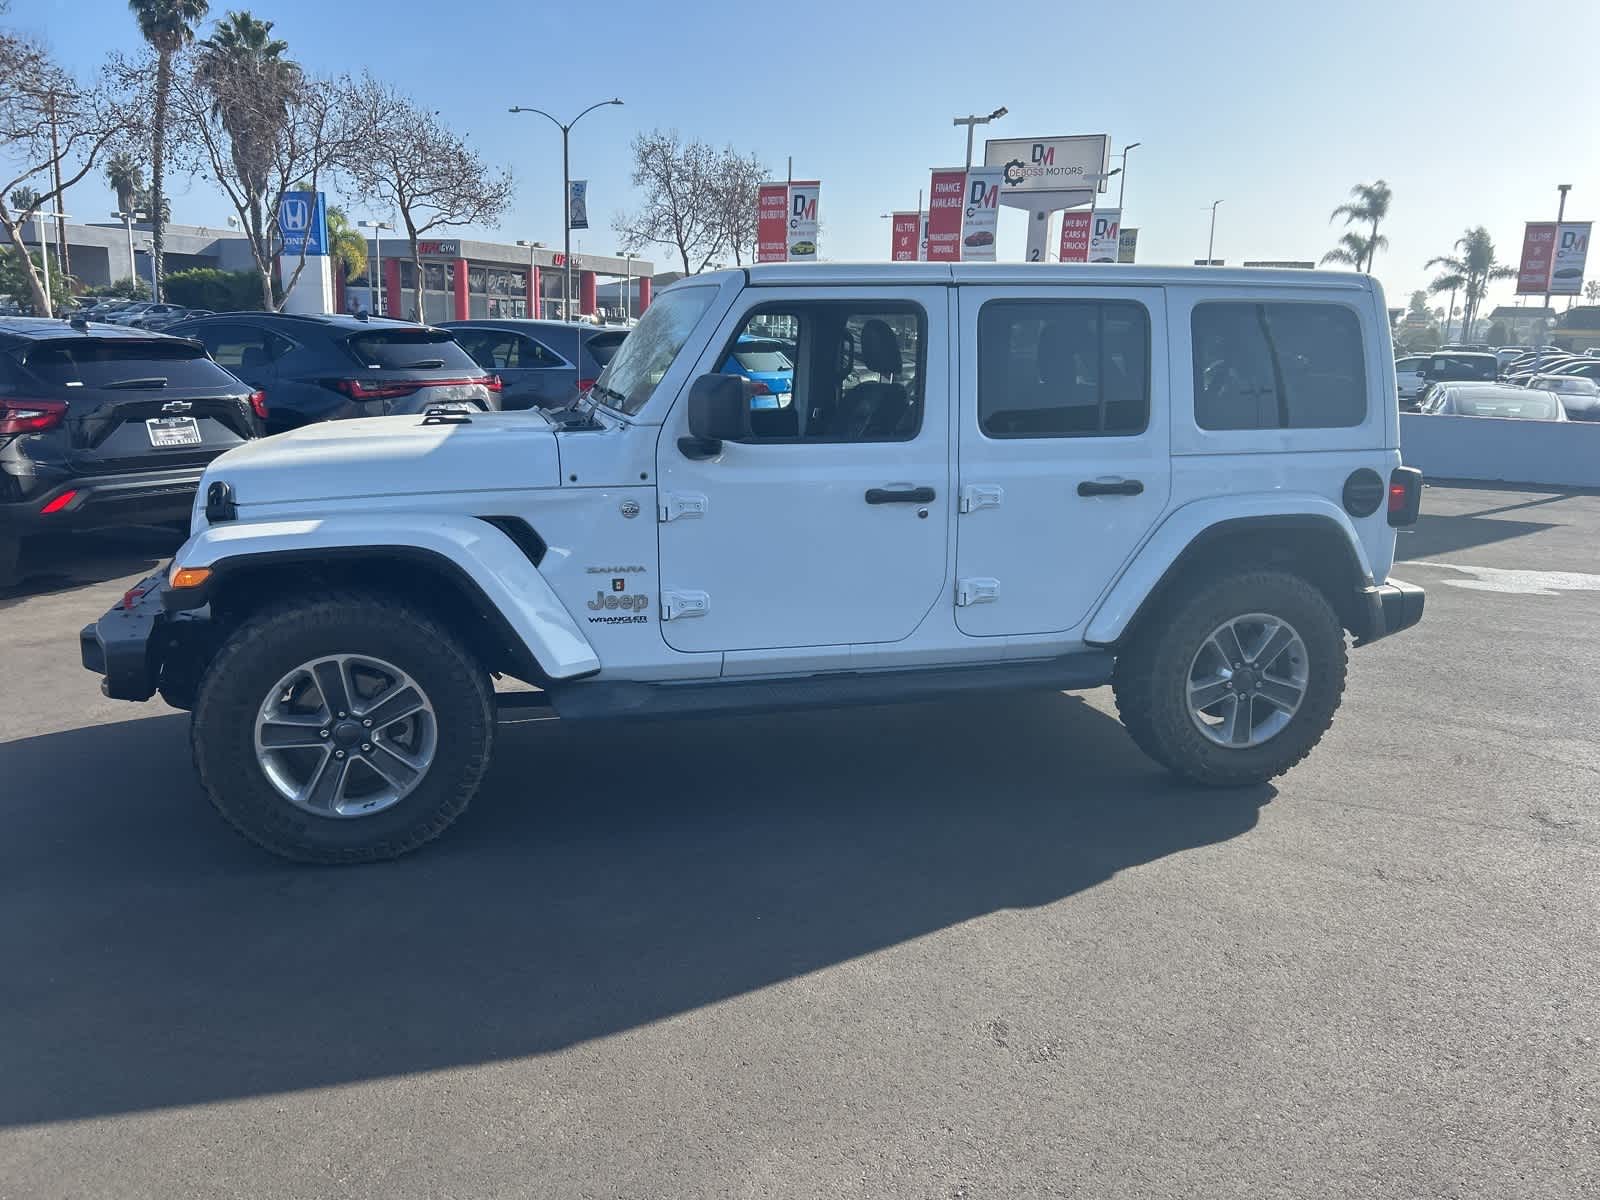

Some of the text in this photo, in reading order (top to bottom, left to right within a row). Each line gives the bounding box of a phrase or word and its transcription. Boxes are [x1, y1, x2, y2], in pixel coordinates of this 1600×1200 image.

[1032, 144, 1055, 166] DM
[1010, 166, 1084, 177] DEBOSS MOTORS
[935, 182, 961, 193] FINANCE
[970, 181, 999, 209] DM
[793, 194, 817, 220] DM
[931, 198, 962, 209] AVAILABLE
[895, 223, 916, 232] ALL TYPE
[1065, 219, 1089, 227] WE BUY
[1064, 230, 1081, 238] CARS
[1095, 219, 1119, 240] DM
[901, 237, 909, 247] OF
[1063, 241, 1087, 250] TRUCKS
[441, 244, 455, 253] GYM
[1031, 248, 1040, 262] 2
[586, 566, 647, 574] SAHARA
[587, 590, 649, 613] Jeep
[588, 615, 648, 624] WRANGLER
